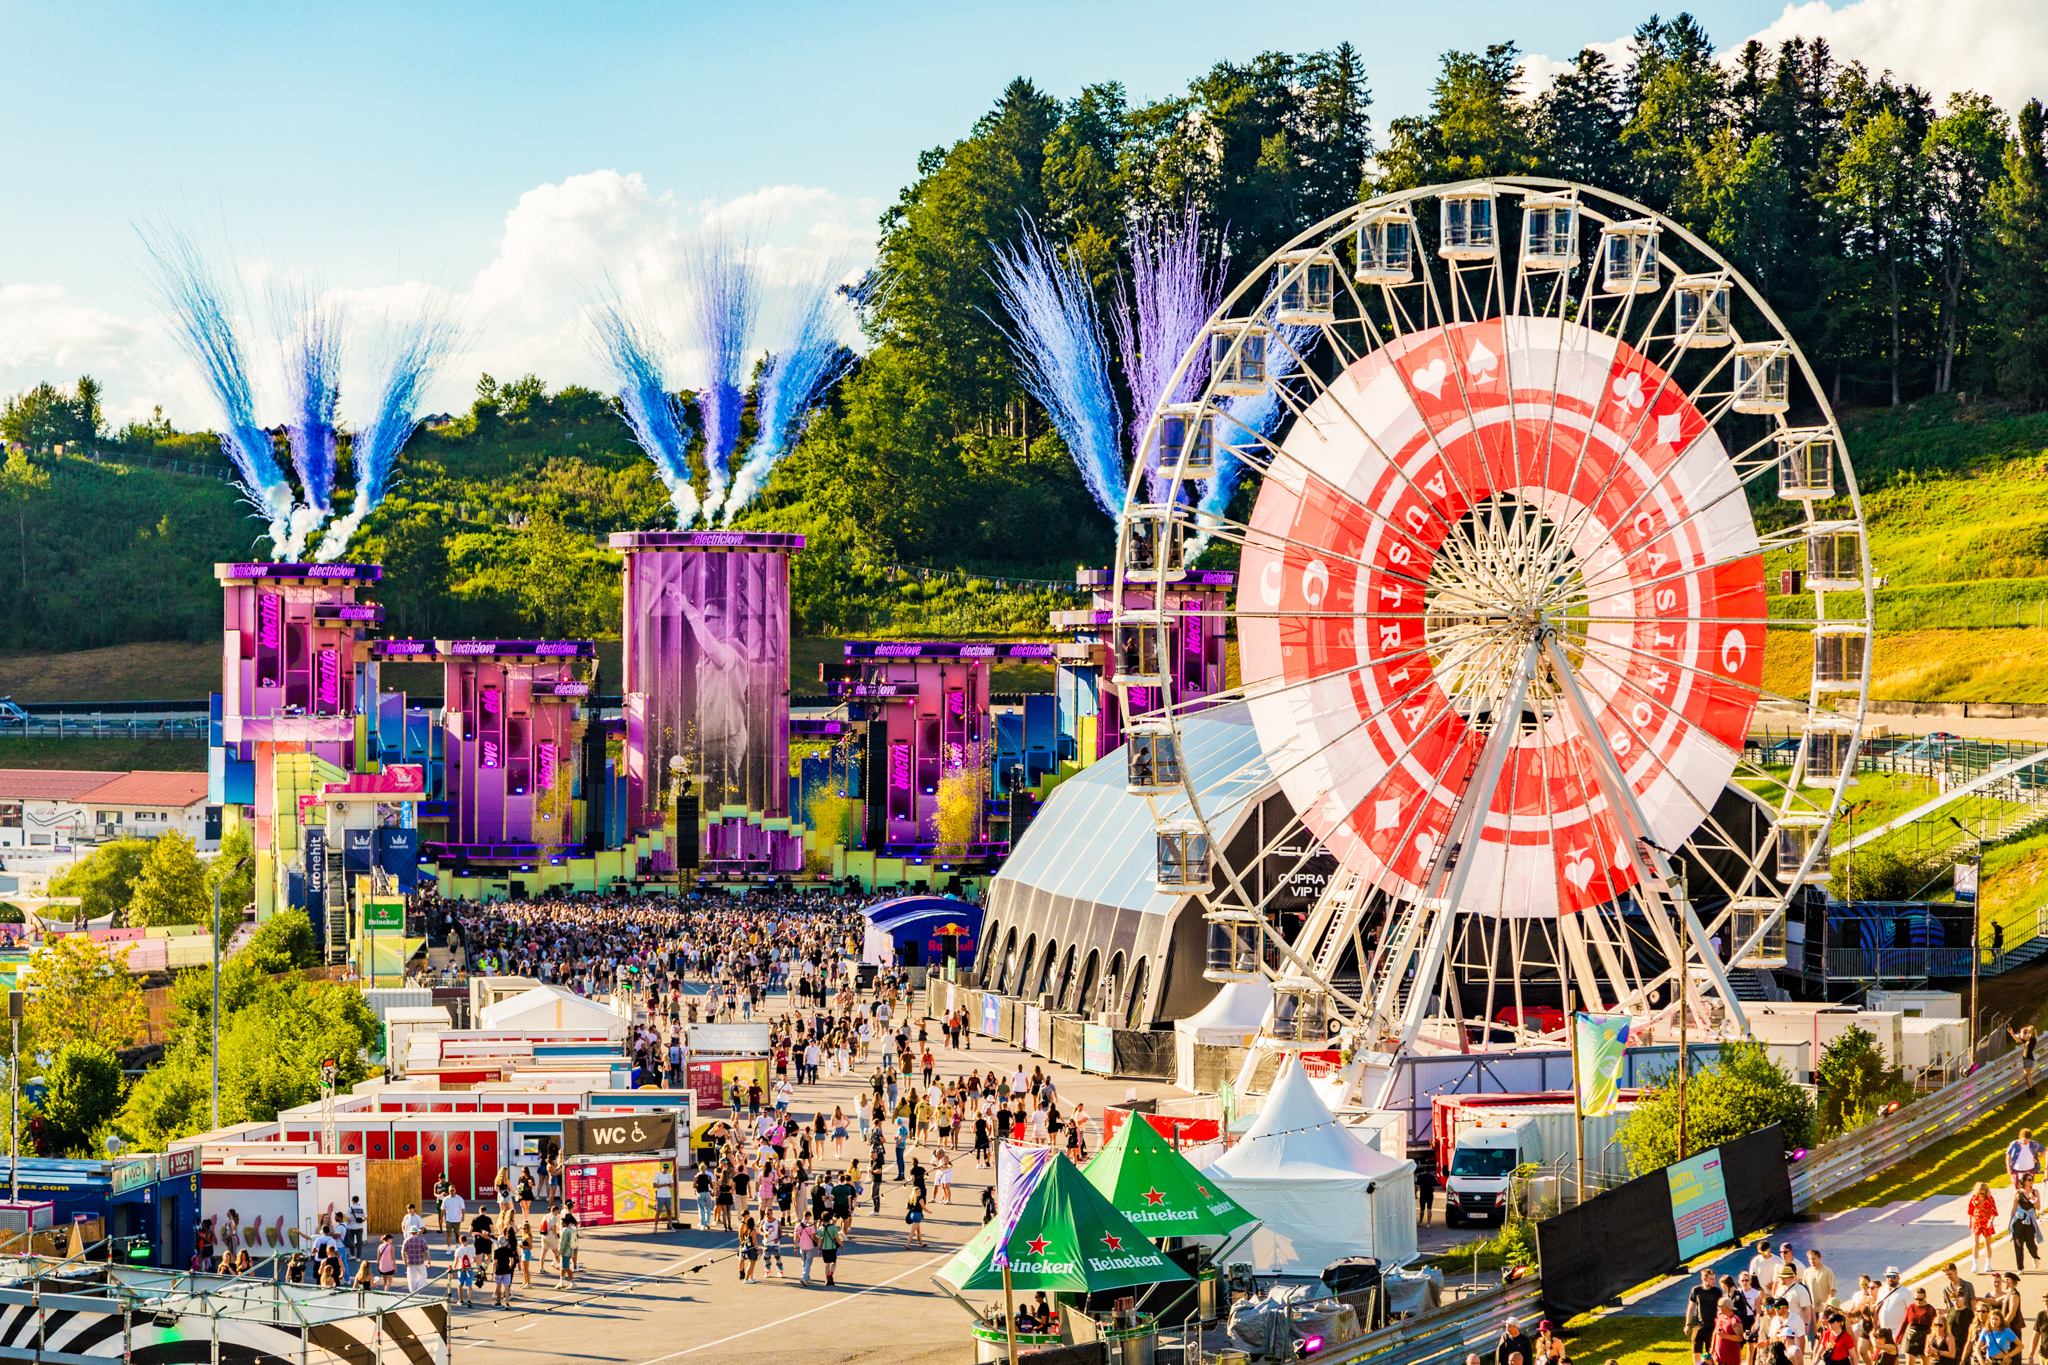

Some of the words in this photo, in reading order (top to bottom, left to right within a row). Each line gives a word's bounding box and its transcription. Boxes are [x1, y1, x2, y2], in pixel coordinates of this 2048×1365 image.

[694, 534, 744, 545] electriclove
[308, 565, 356, 577] electriclove
[1380, 469, 1448, 732] AUSTRIA
[1611, 511, 1676, 757] CASINOS
[452, 642, 496, 654] electriclove
[874, 644, 922, 656] electriclove
[310, 836, 321, 893] kronehit
[1291, 886, 1312, 897] VIP
[928, 939, 942, 951] Re
[593, 1126, 627, 1145] WC
[174, 1154, 188, 1166] WC
[128, 1166, 141, 1179] WC
[1120, 1207, 1199, 1223] Heineken
[988, 1258, 1076, 1274] Heineken
[1088, 1253, 1164, 1272] Heineken
